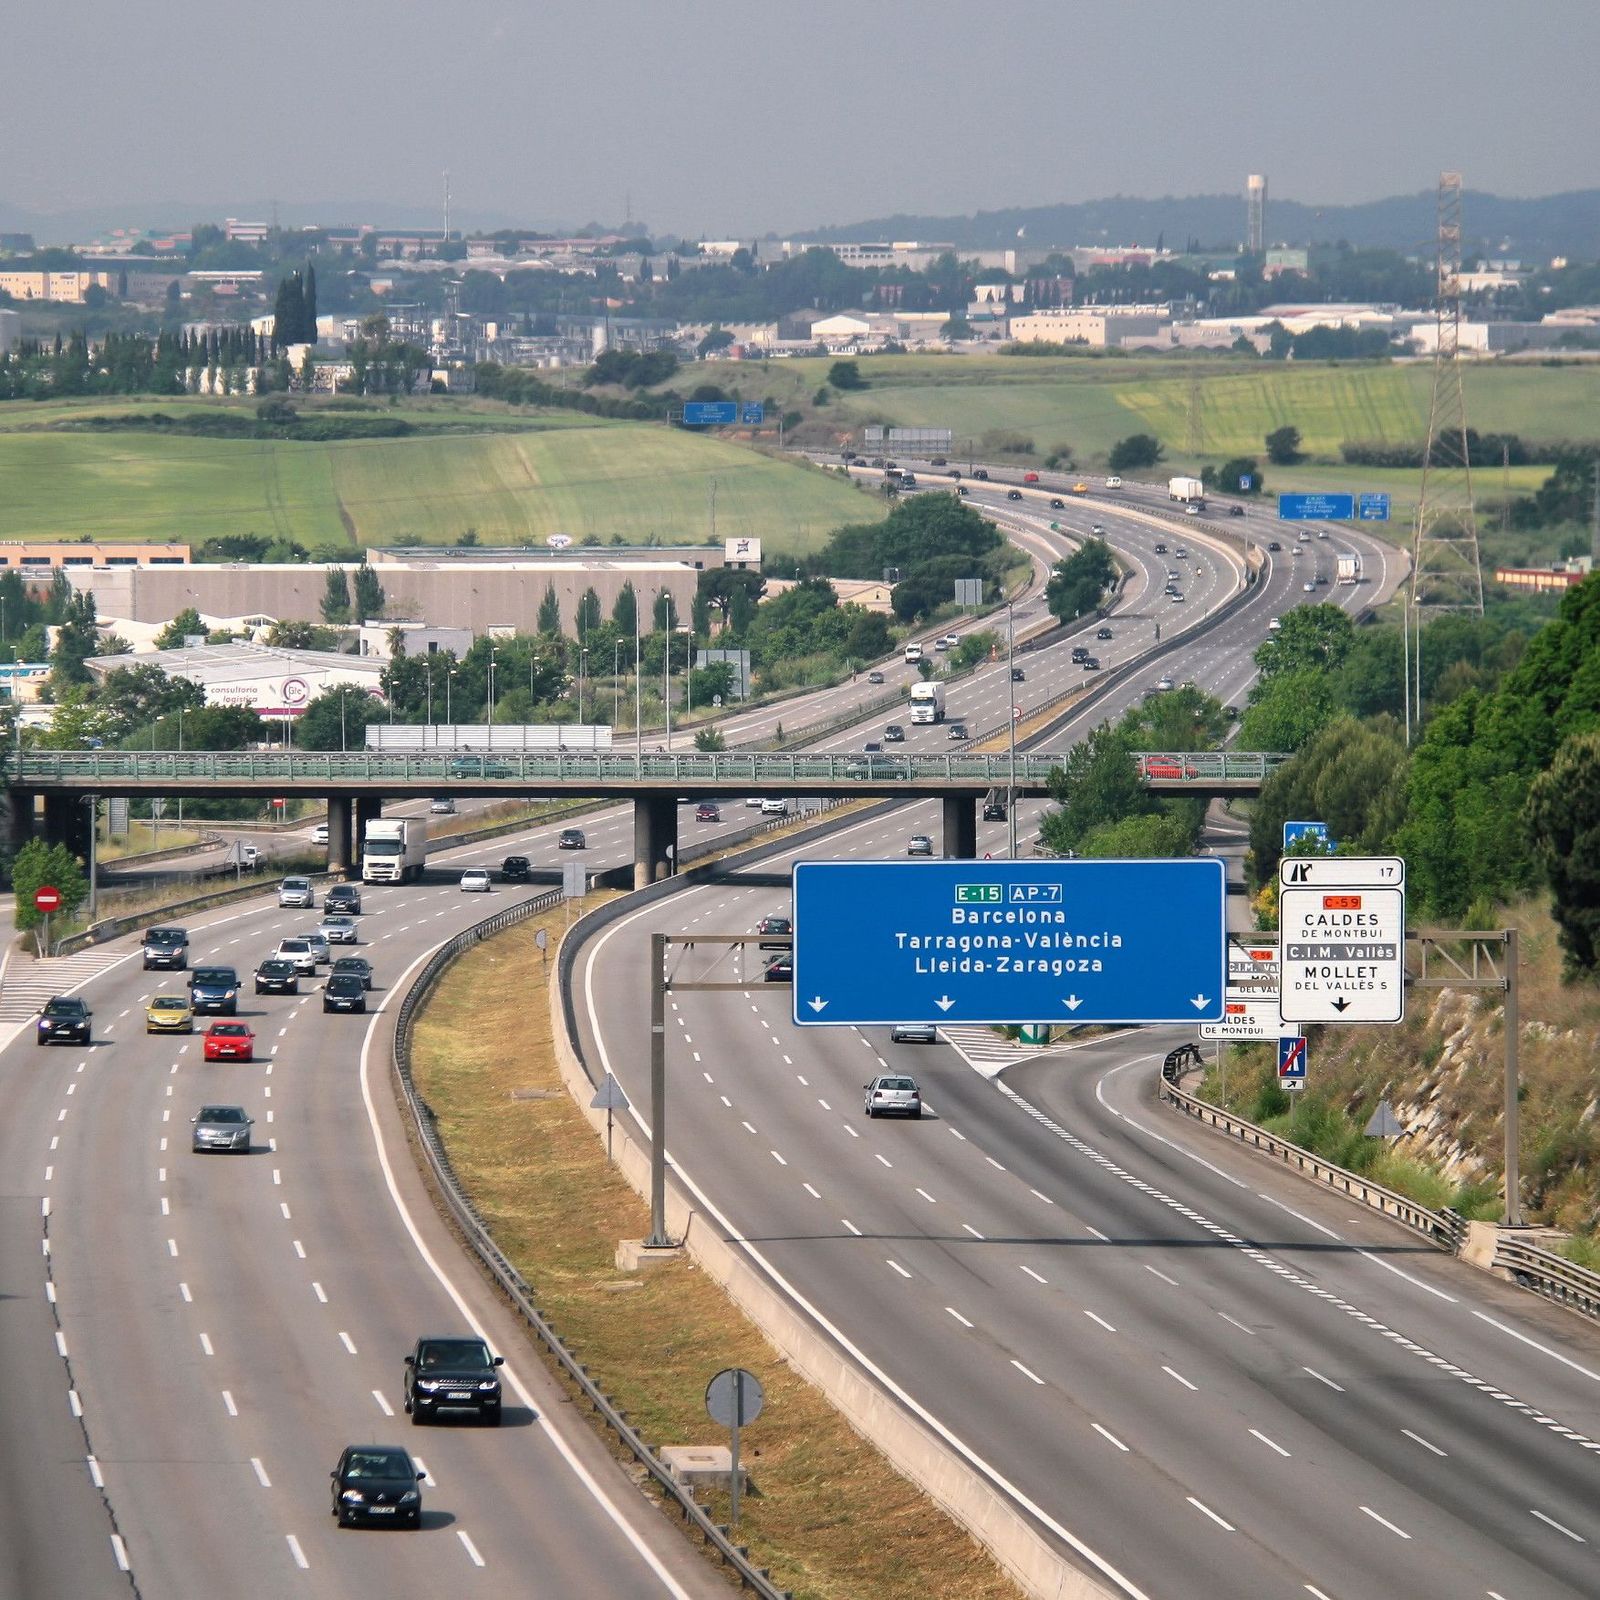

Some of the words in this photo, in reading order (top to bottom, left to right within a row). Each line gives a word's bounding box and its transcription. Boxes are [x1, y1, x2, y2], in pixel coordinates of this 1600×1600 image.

[1380, 867, 1394, 877] 17
[957, 887, 1000, 900] E-15
[1012, 887, 1060, 900] AP-7
[1325, 897, 1359, 907] C-59
[952, 908, 1066, 924] Barcelona
[1305, 914, 1379, 926] CALDES
[1302, 929, 1318, 938] DE
[1324, 929, 1383, 938] MONTBUI
[895, 932, 1123, 953] Tarragona-València
[1290, 946, 1338, 958] C.I.M.
[1345, 946, 1395, 958] Vallès
[915, 957, 1103, 977] Lleida-Zaragoza
[1263, 963, 1280, 972] Val
[1305, 966, 1379, 979] MOLLET
[1295, 981, 1320, 990] DEL
[1326, 980, 1375, 990] VALLÈS
[1380, 981, 1388, 990] S
[1224, 1016, 1256, 1025] LDES
[1205, 1026, 1217, 1034] DE
[1221, 1026, 1264, 1035] MONTBUI
